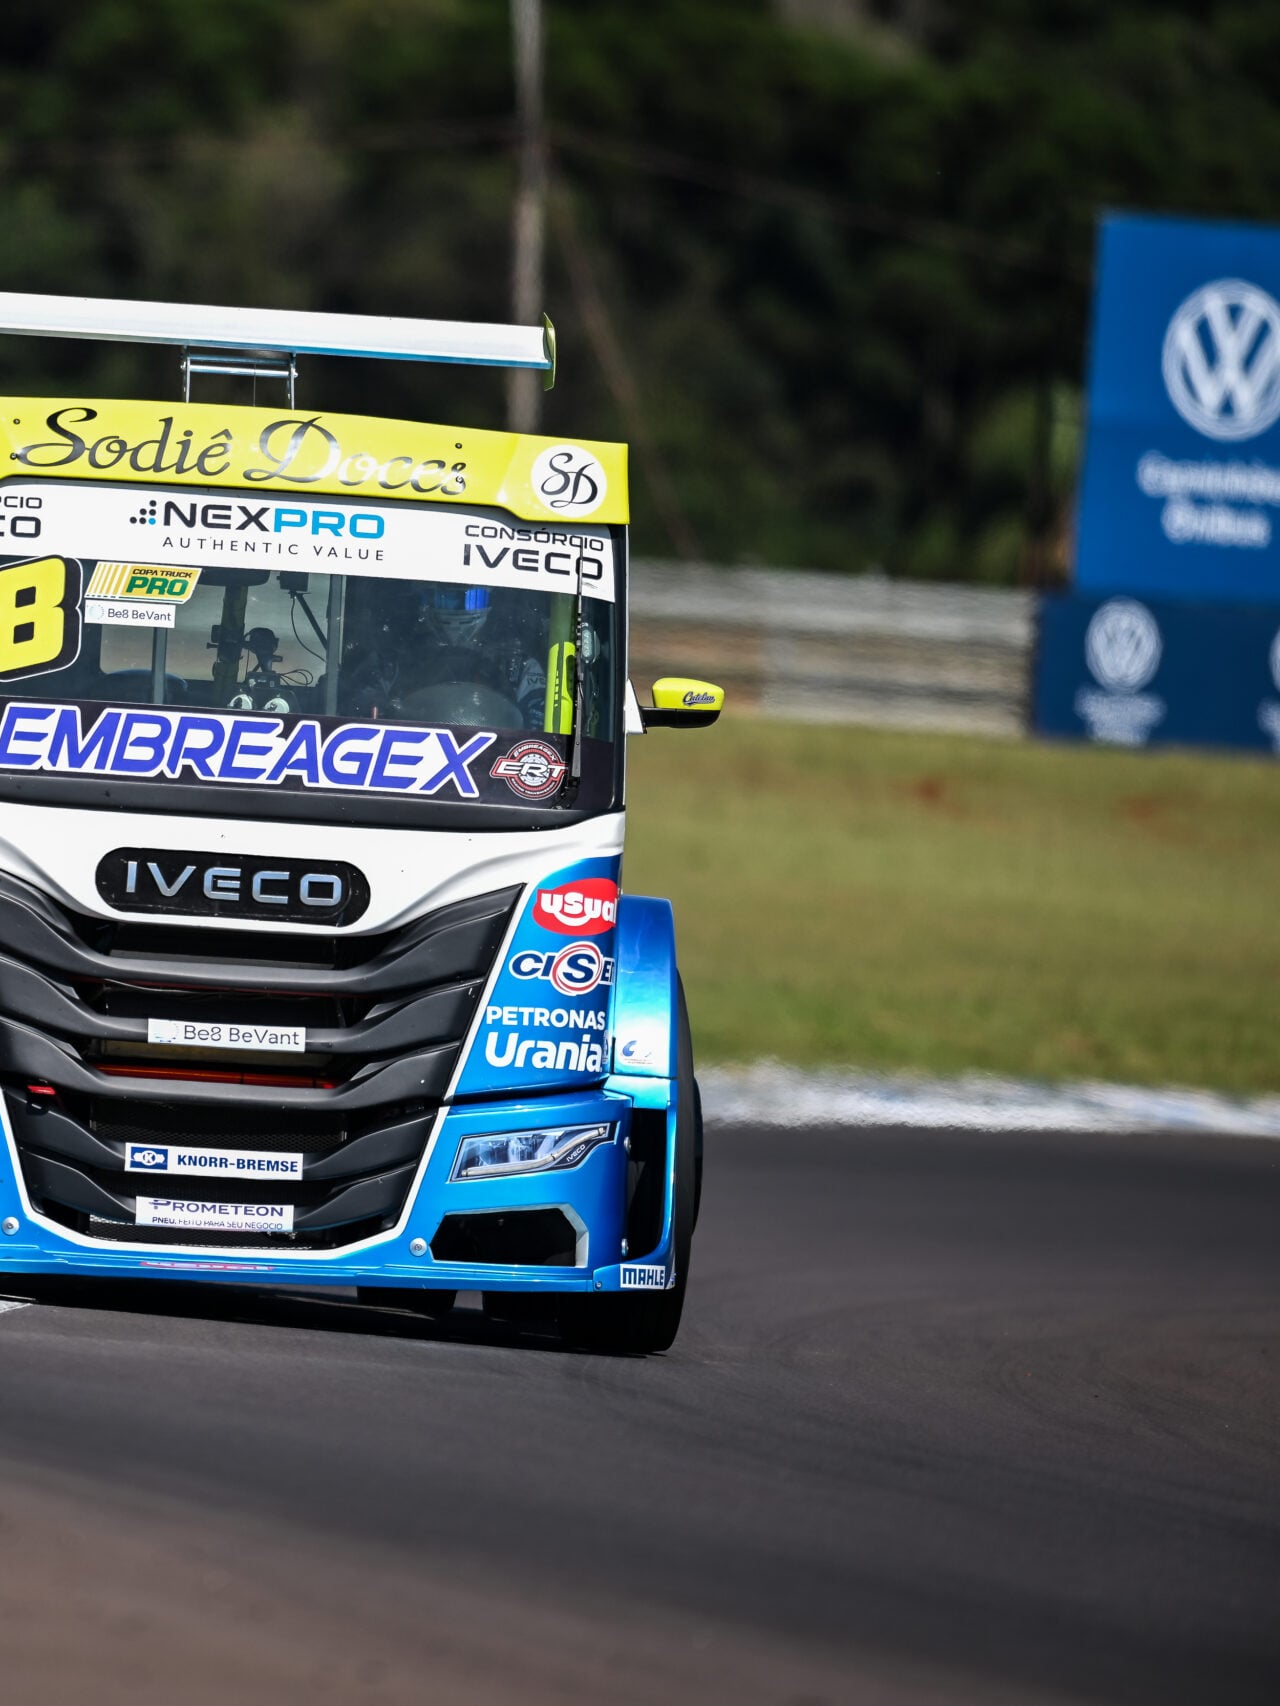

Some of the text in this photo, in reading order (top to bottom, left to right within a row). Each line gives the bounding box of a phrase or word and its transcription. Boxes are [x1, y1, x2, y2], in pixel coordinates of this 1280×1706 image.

[16, 407, 468, 496] Sodiê Doces
[163, 500, 386, 540] NEXPRO
[162, 536, 385, 561] AUTHENTIC VALUE
[464, 524, 604, 552] CONSÓRCIO
[132, 568, 193, 578] COPA TRUCK
[463, 543, 603, 581] IVECO
[125, 576, 190, 597] PRO
[107, 608, 172, 622] Be8 BeVant
[495, 761, 569, 778] ERT
[125, 860, 343, 907] IVECO
[485, 1005, 606, 1031] PETRONAS
[183, 1024, 300, 1046] Be8 BeVant
[484, 1031, 603, 1073] Urania
[176, 1153, 299, 1173] KNORR-BREMSE
[147, 1198, 284, 1217] PROMETEON
[151, 1216, 177, 1225] PNEU.
[226, 1221, 243, 1229] SEU
[622, 1267, 665, 1286] MAHLE
